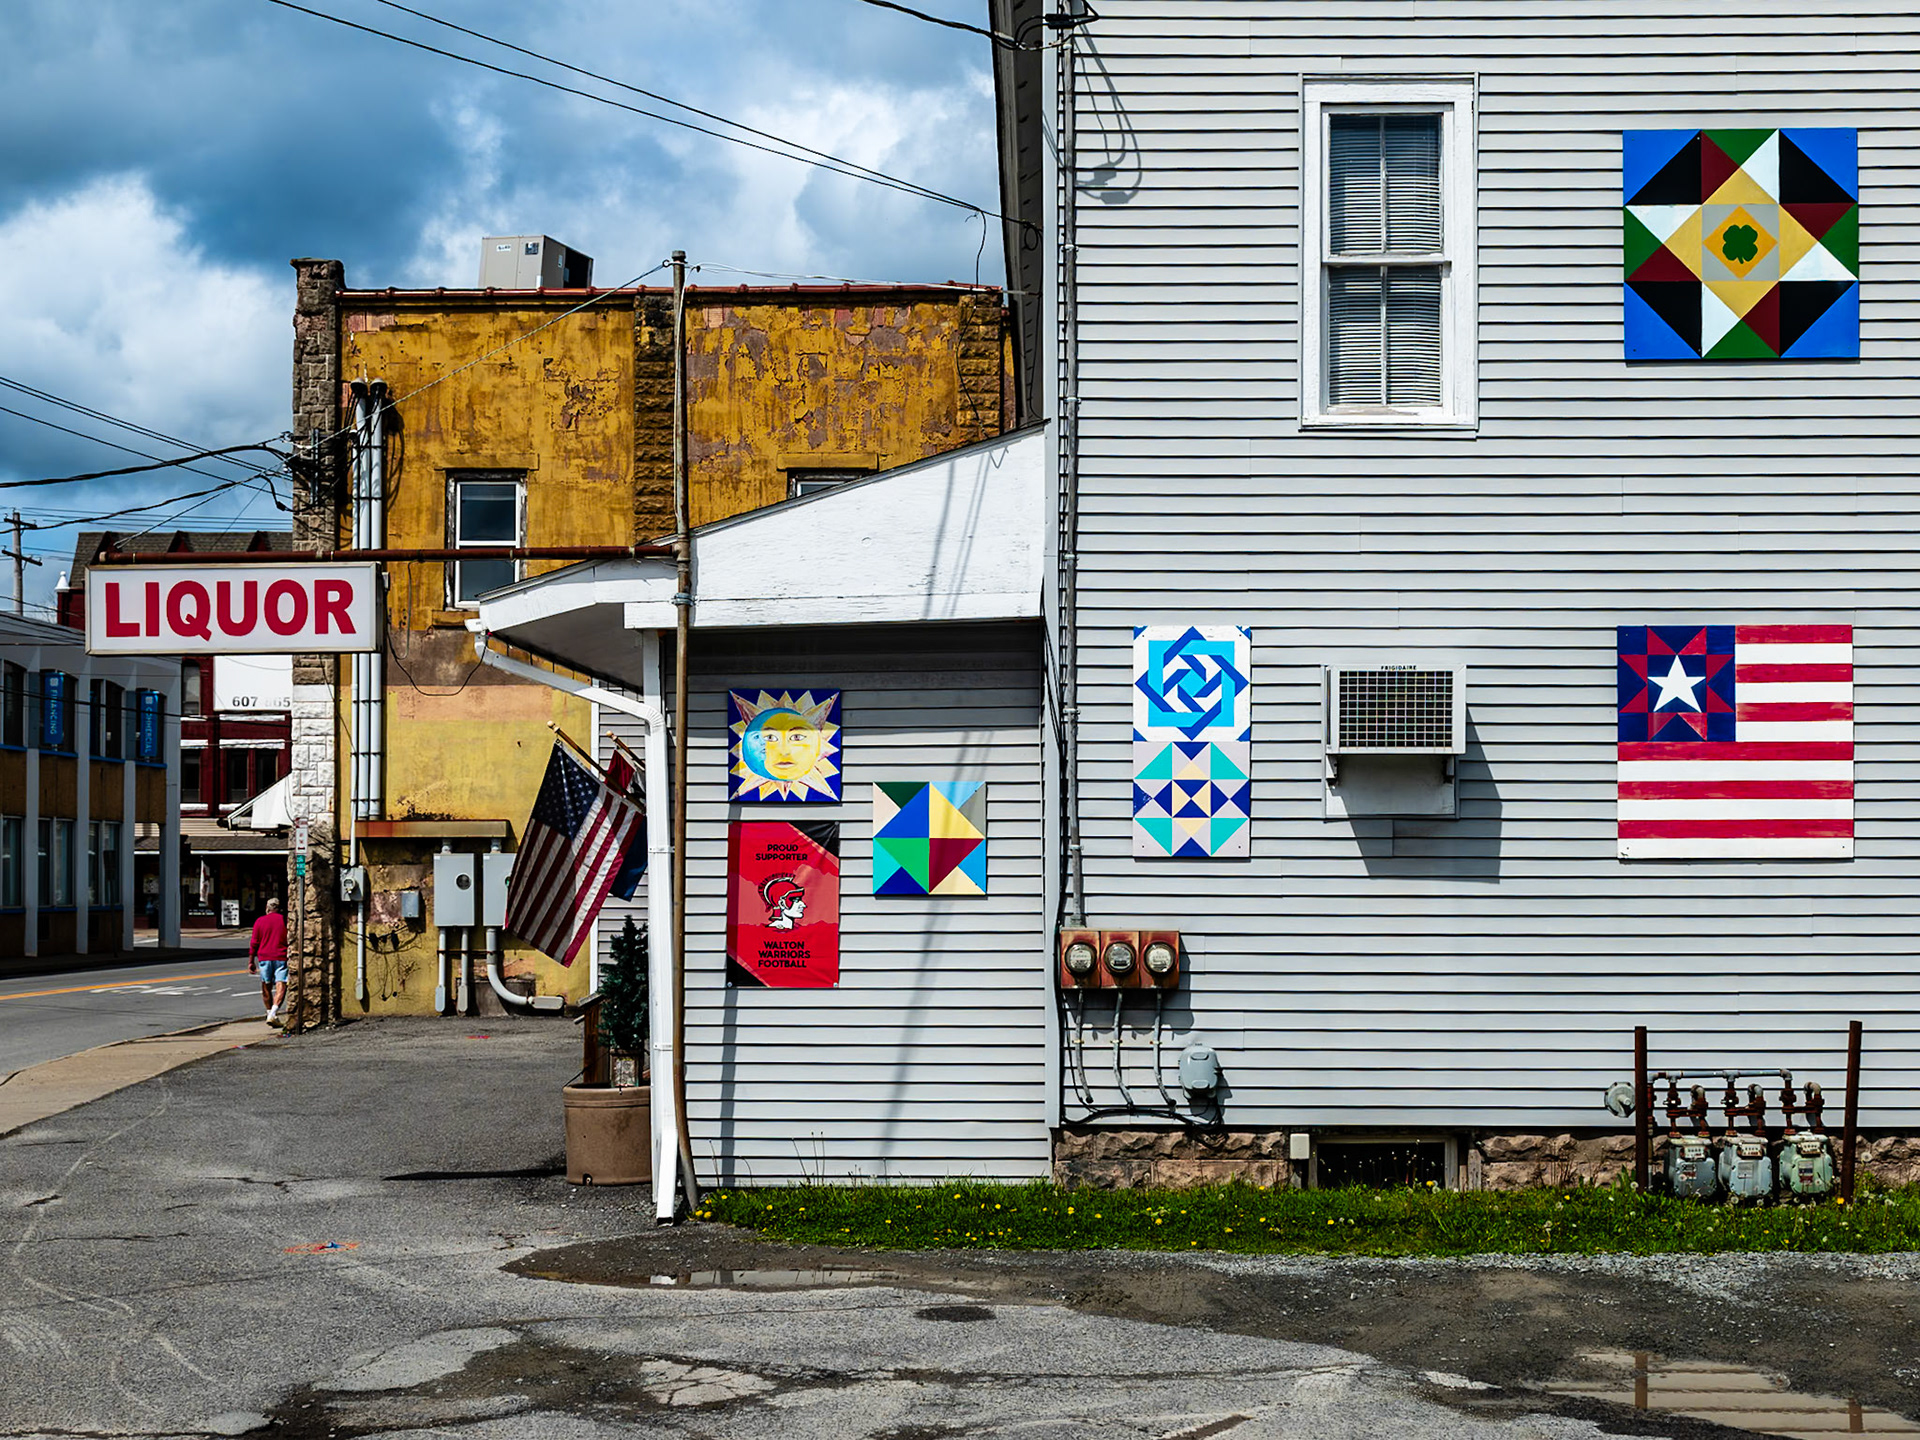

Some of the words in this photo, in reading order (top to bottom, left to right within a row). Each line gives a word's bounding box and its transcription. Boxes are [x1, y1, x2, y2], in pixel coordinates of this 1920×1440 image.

[105, 579, 357, 642] LIQUOR
[232, 696, 258, 707] 607
[767, 844, 799, 852] PROUD
[755, 853, 808, 861] SUPPORTER
[763, 941, 805, 950] WALTON
[758, 950, 811, 959] WARRIORS
[758, 959, 807, 968] FOOTBALL
